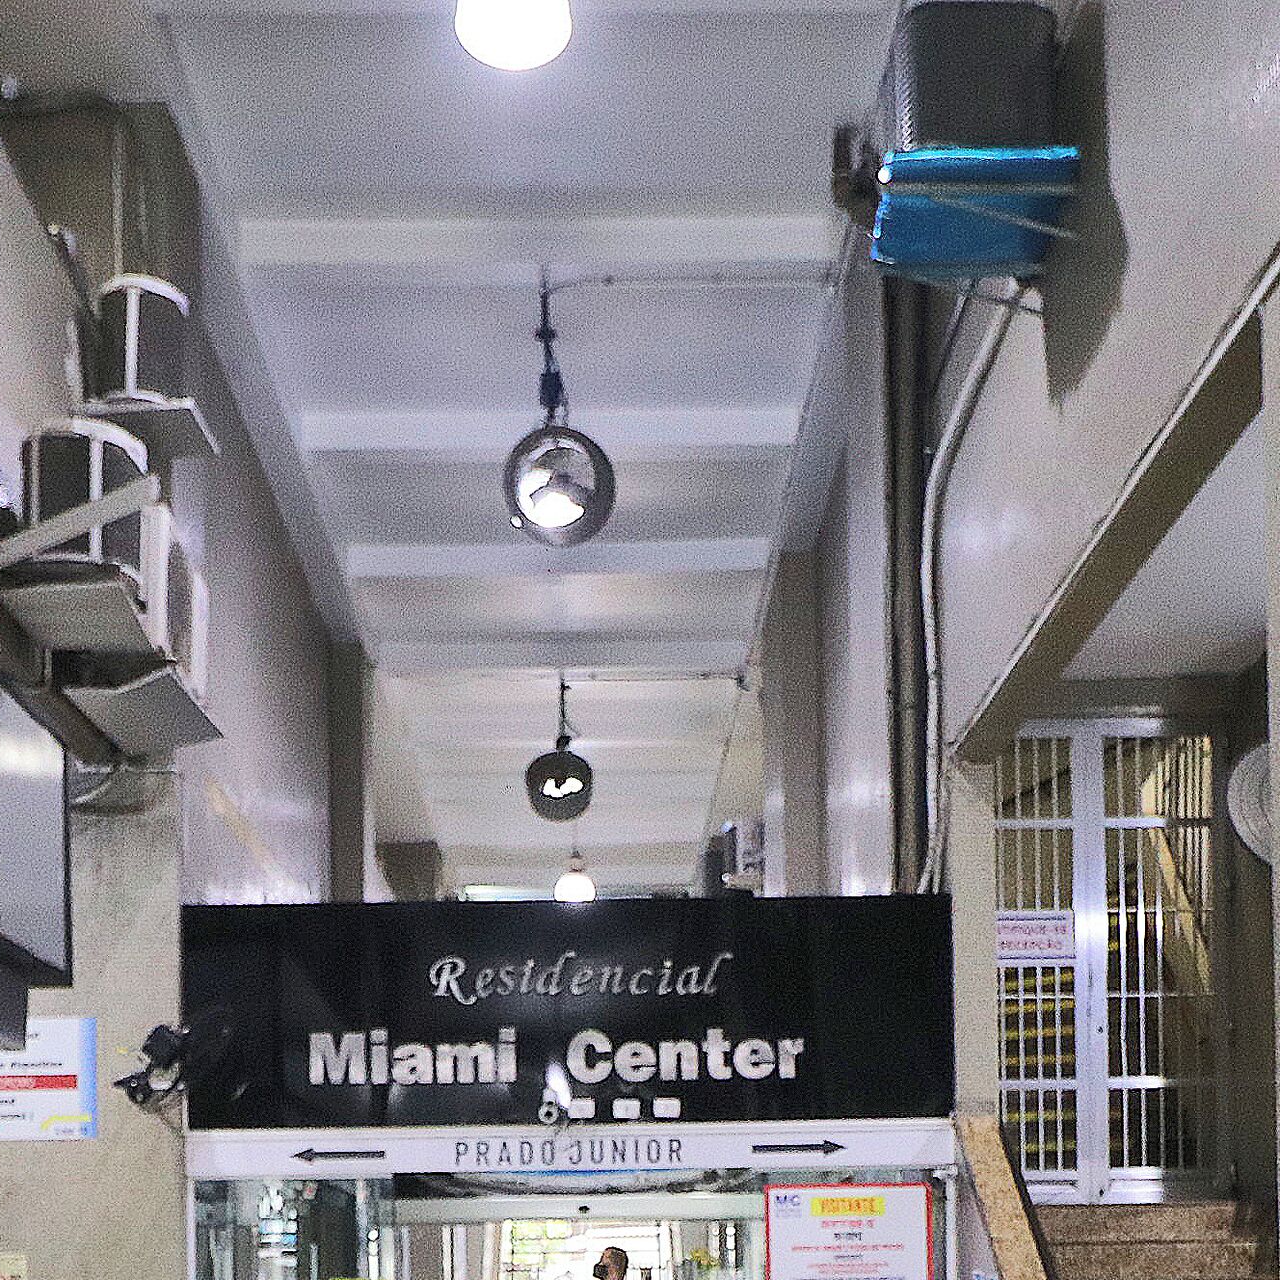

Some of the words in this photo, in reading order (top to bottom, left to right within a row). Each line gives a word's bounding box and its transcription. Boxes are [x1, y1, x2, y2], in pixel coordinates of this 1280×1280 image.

[430, 951, 733, 1005] Residencial
[309, 1027, 517, 1085] Miami
[567, 1028, 804, 1083] Center
[455, 1140, 556, 1166] PRADO
[568, 1138, 684, 1165] JUNIOR
